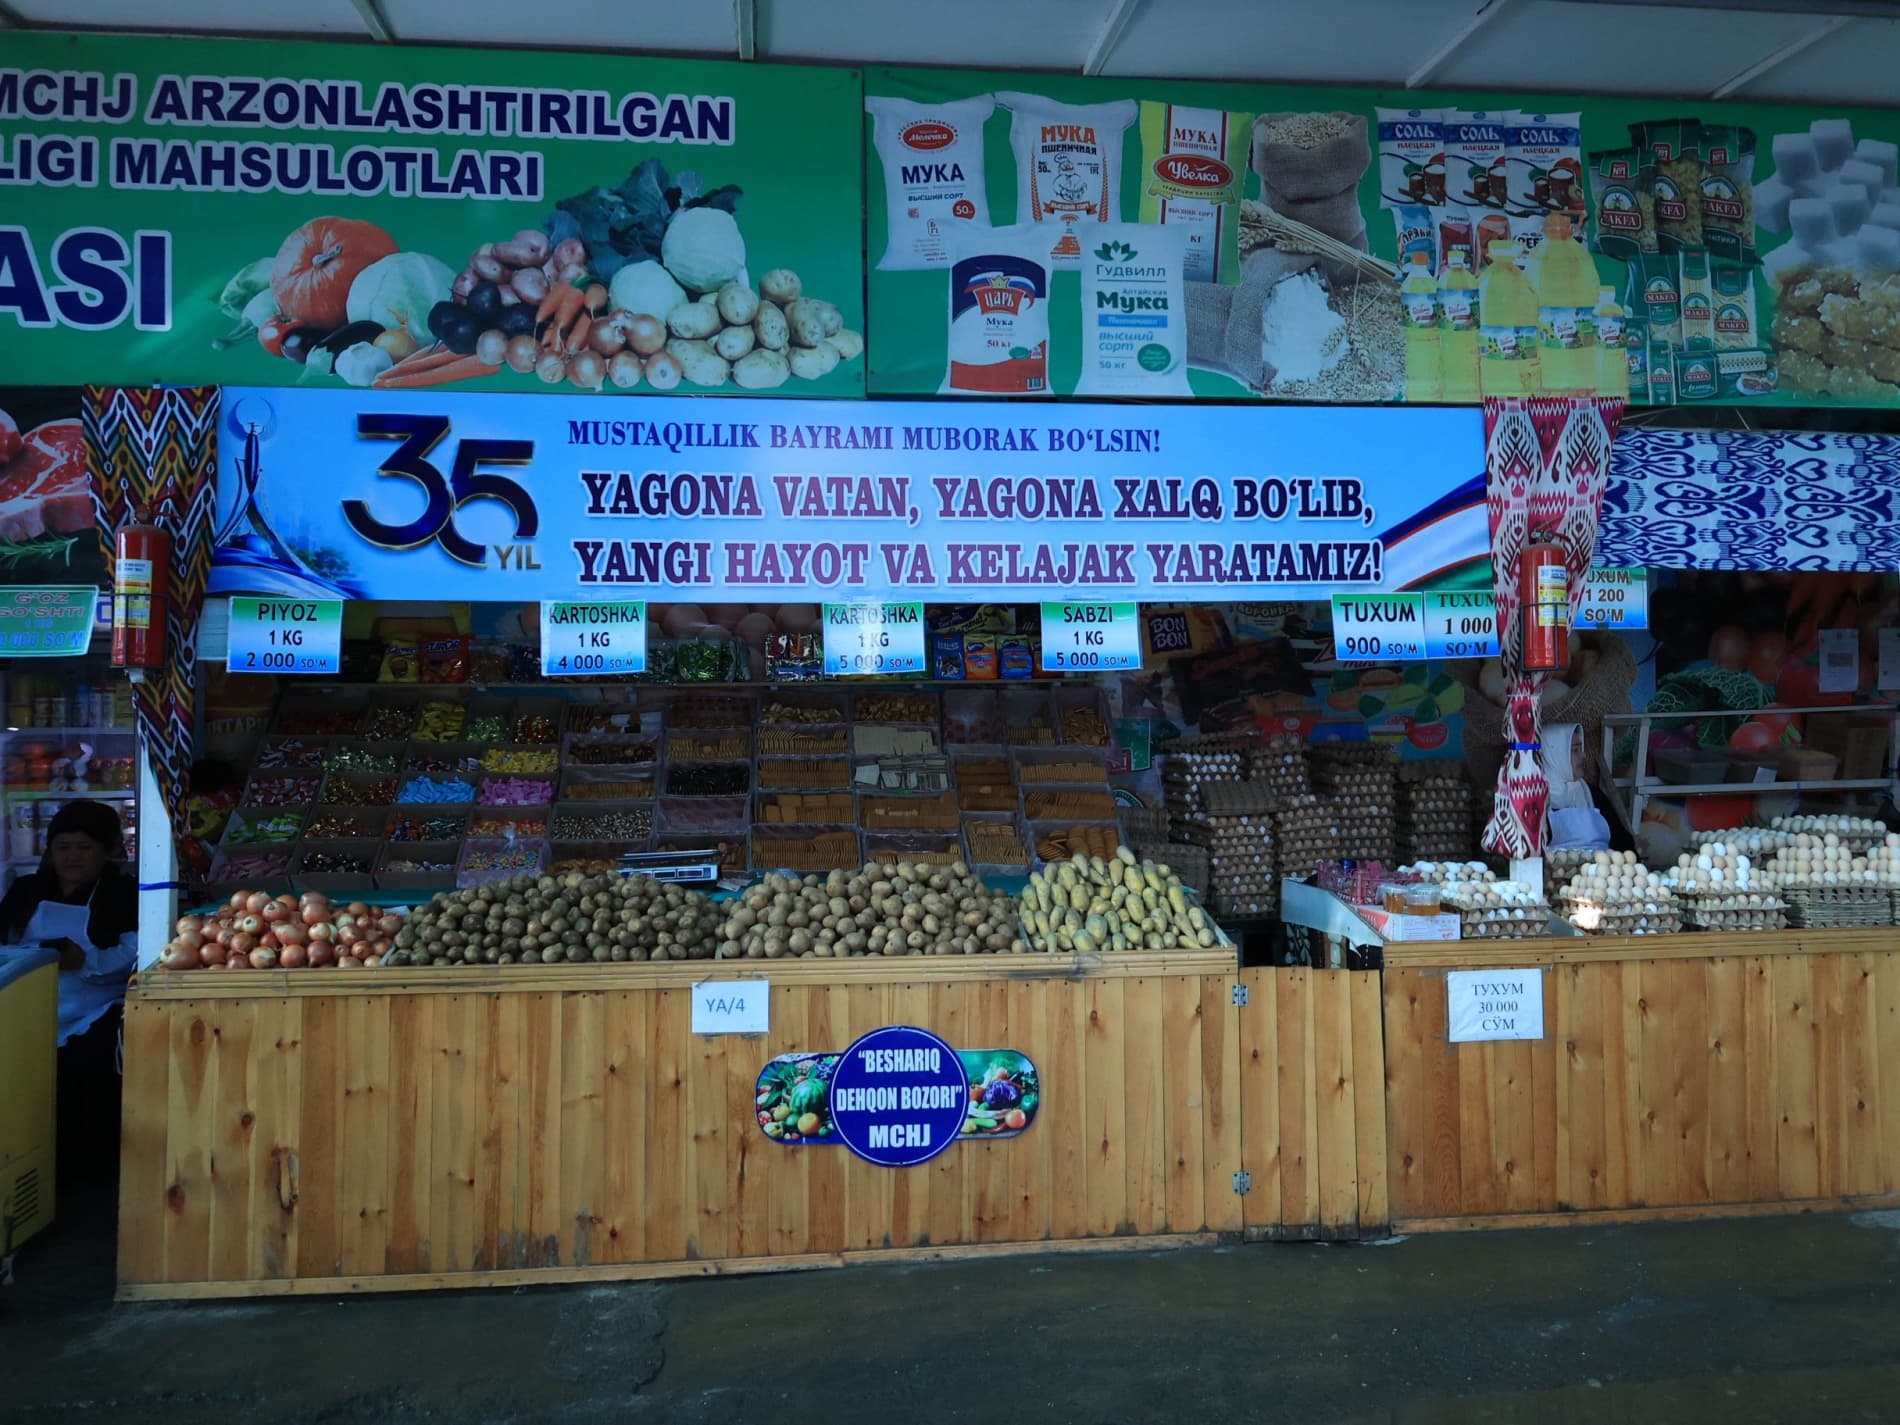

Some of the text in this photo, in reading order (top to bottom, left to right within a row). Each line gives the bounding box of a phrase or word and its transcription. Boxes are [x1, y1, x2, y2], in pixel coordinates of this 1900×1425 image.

[150, 79, 731, 142] ARZONLASHTIRILGAN
[1041, 125, 1096, 145] МУКА
[1174, 128, 1217, 144] МУКА
[1395, 123, 1435, 138] СОЛЬ
[1460, 126, 1500, 141] СОЛЬ
[1520, 129, 1560, 144] СОЛЬ
[1041, 144, 1097, 155] ПШЕНИЧНАЯ
[115, 142, 540, 198] MAHSULOTLARI
[901, 163, 965, 184] МУКА
[1167, 161, 1219, 184] Увелка
[907, 192, 964, 201] ВЫСШИЙ СОРТ
[955, 205, 969, 215] 50
[1096, 291, 1168, 314] Мука
[1647, 293, 1675, 301] MAKFA
[986, 317, 1013, 328] Мука
[1719, 321, 1745, 329] MAKFA
[1099, 342, 1134, 353] сорт
[1099, 361, 1112, 369] 50
[568, 420, 759, 453] MUSTAQILLIK
[770, 424, 893, 451] BAYRAMI
[903, 428, 1038, 452] MUBORAK
[342, 413, 539, 568] 35
[583, 474, 761, 514] YAGONA
[774, 476, 919, 524] VATAN,
[932, 478, 1104, 518] YAGONA
[1114, 479, 1223, 520] XALQ
[494, 545, 541, 570] YIL
[575, 542, 1383, 583] YANGI HAYOT VA KELAJAK YARATAMIZ!
[1586, 588, 1624, 602] 1 200
[258, 603, 317, 621] PIYOZ
[549, 606, 640, 624] KARTOSHKA
[830, 607, 918, 625] KARTOSHKA
[1063, 606, 1113, 623] SABZI
[1341, 602, 1415, 622] TUXUM
[1151, 617, 1186, 633] BON
[1444, 617, 1492, 634] 1 000
[269, 631, 302, 645] 1 KG
[578, 632, 610, 647] 1 KG
[858, 634, 889, 647] 1 KG
[1073, 631, 1104, 645] 1 KG
[1154, 632, 1189, 649] BON
[1346, 637, 1381, 655] 900
[1388, 644, 1417, 655] SO'M
[246, 653, 326, 668] 2 000 SO'M
[558, 655, 633, 669] 4 000 SO'M
[840, 655, 848, 668] 5
[855, 655, 883, 669] 000
[1056, 652, 1128, 665] 5 000 SO'M
[1471, 983, 1523, 996] ТУХУМ
[705, 998, 745, 1013] YA/4
[1478, 1001, 1518, 1014] 30 000
[858, 1048, 941, 1074] “BESHARIQ
[836, 1085, 963, 1111] DEHQON BOZORI”
[868, 1124, 931, 1148] MCHJ
